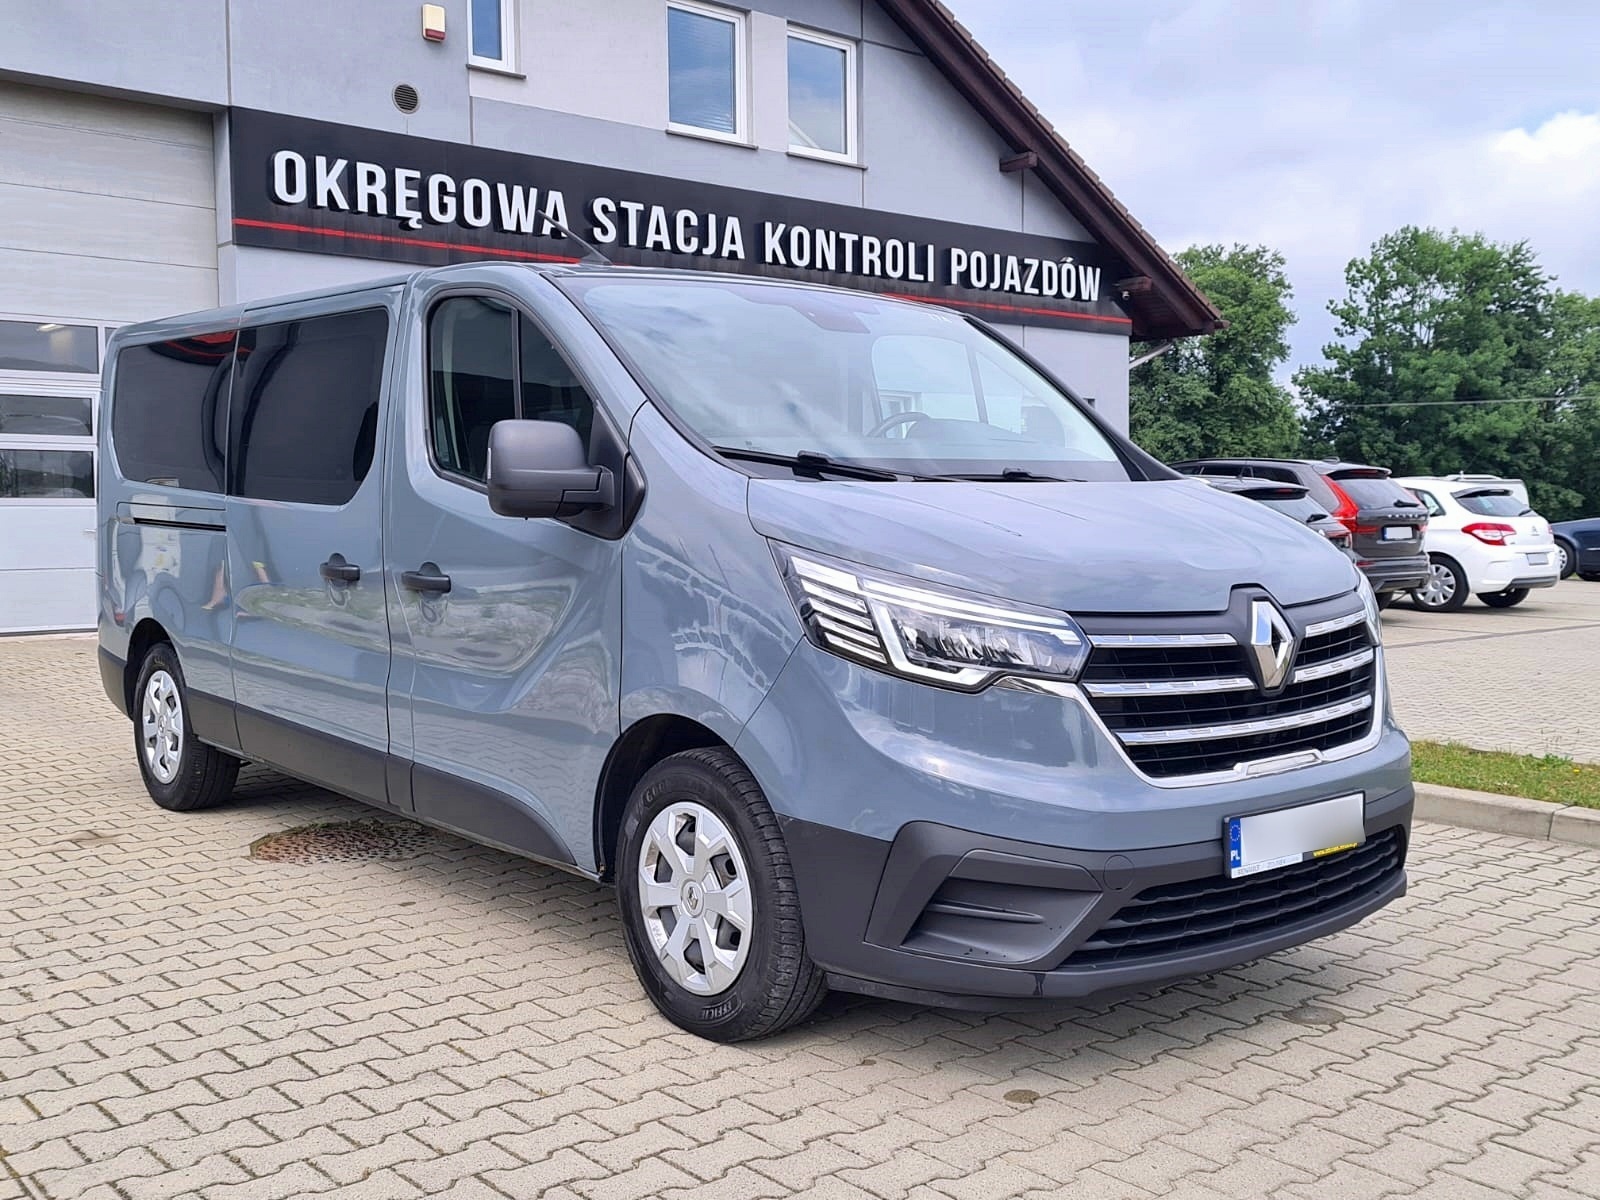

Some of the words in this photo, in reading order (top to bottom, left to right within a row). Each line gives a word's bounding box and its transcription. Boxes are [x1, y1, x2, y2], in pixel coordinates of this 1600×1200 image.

[273, 150, 568, 238] OKRĘGOWA
[592, 197, 745, 259] STACJA
[765, 221, 934, 282] KONTROLI
[950, 247, 1101, 302] POJAZDÓW
[1230, 849, 1241, 862] PL
